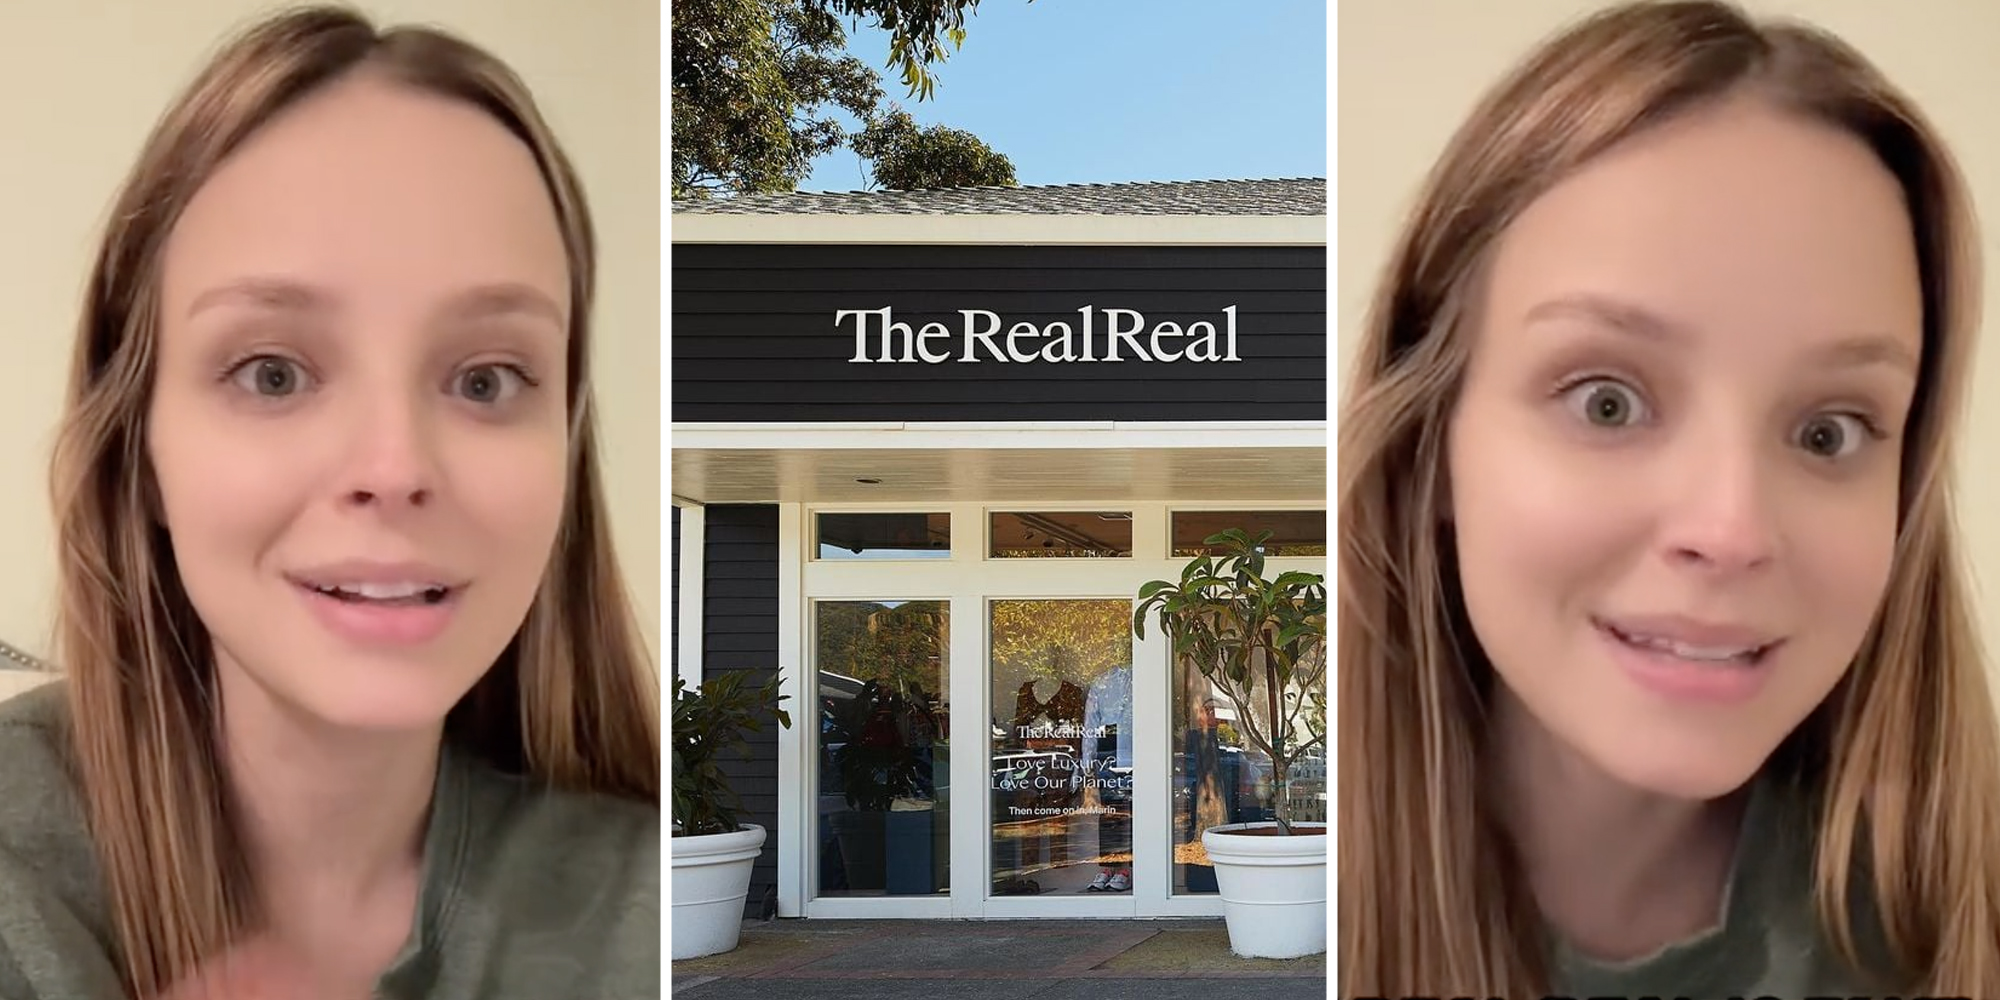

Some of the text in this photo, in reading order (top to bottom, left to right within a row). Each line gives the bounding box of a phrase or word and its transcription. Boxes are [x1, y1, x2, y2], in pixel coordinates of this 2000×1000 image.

[991, 775, 1133, 790] Love Our Planet?
[1008, 806, 1033, 815] Then
